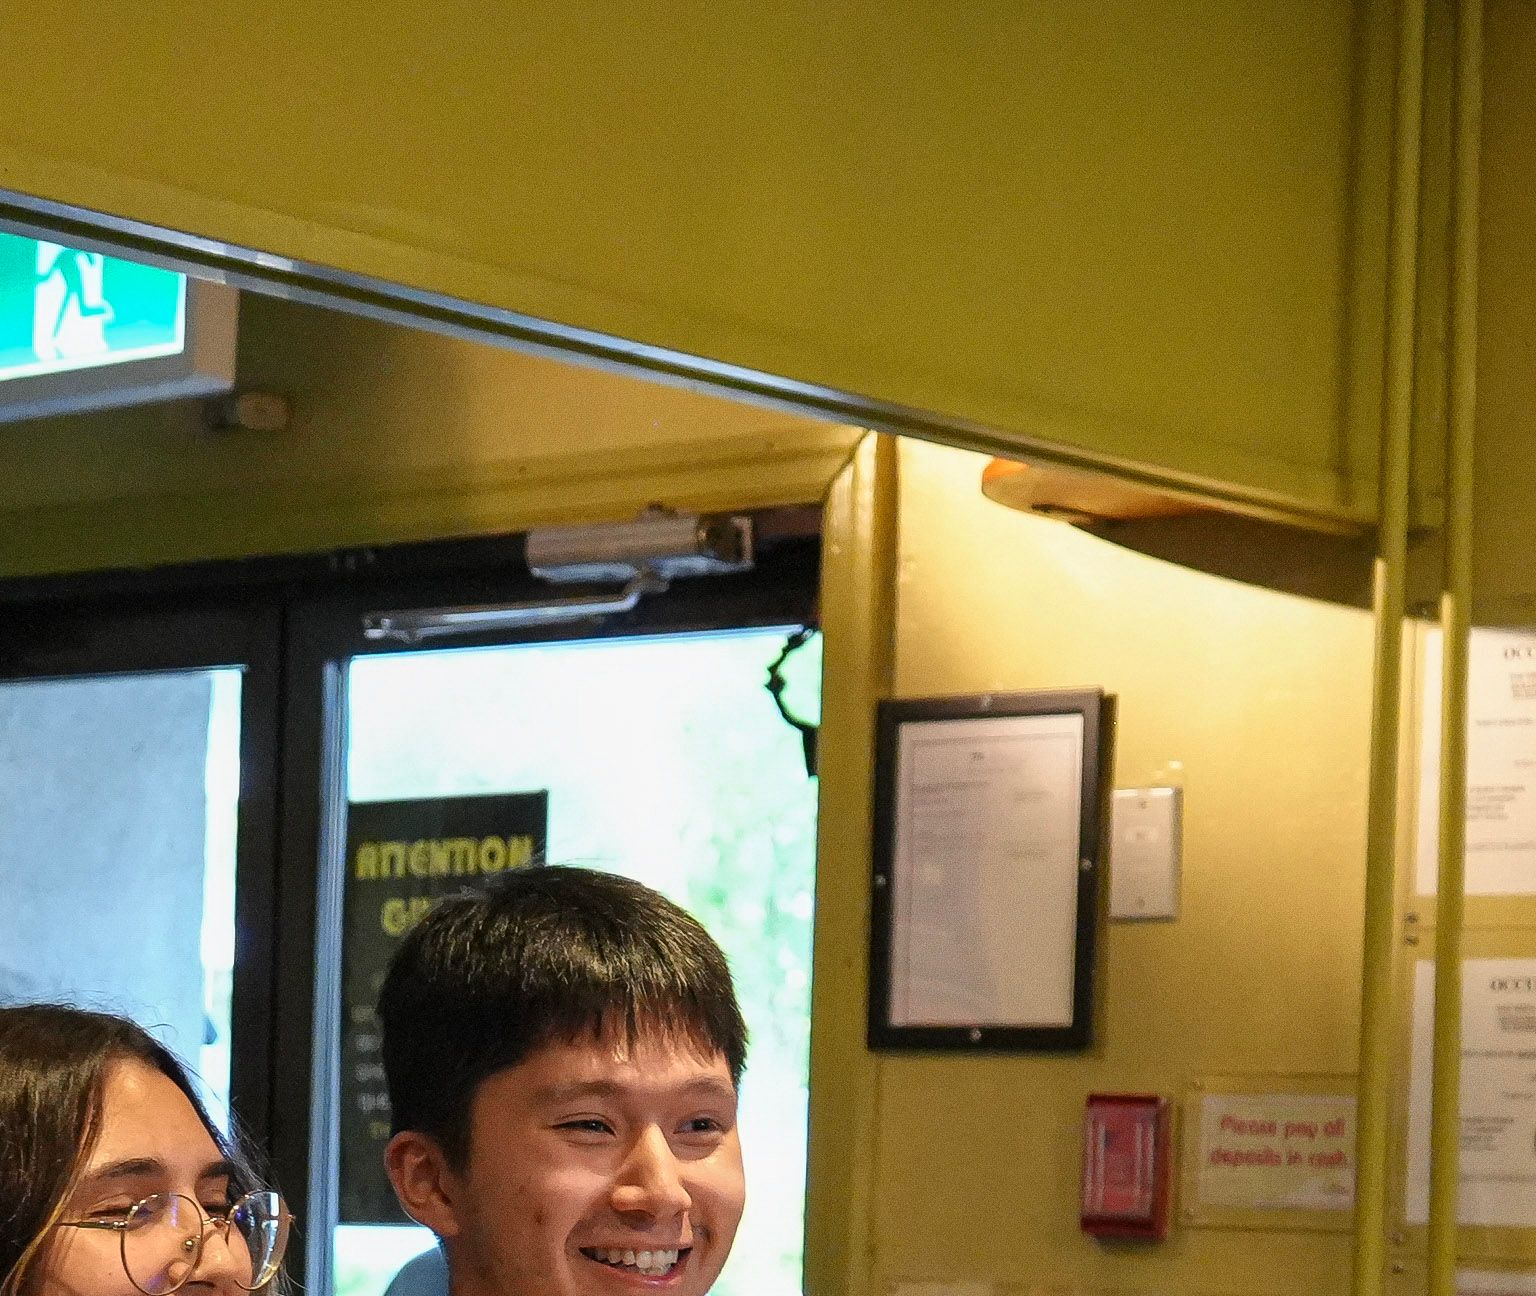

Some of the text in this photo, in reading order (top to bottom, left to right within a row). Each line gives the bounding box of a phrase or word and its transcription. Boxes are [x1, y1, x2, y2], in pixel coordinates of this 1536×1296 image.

[355, 834, 533, 878] ATTENTION
[1220, 1115, 1277, 1137] Please
[1284, 1121, 1318, 1140] pay
[1210, 1147, 1282, 1166] deposits
